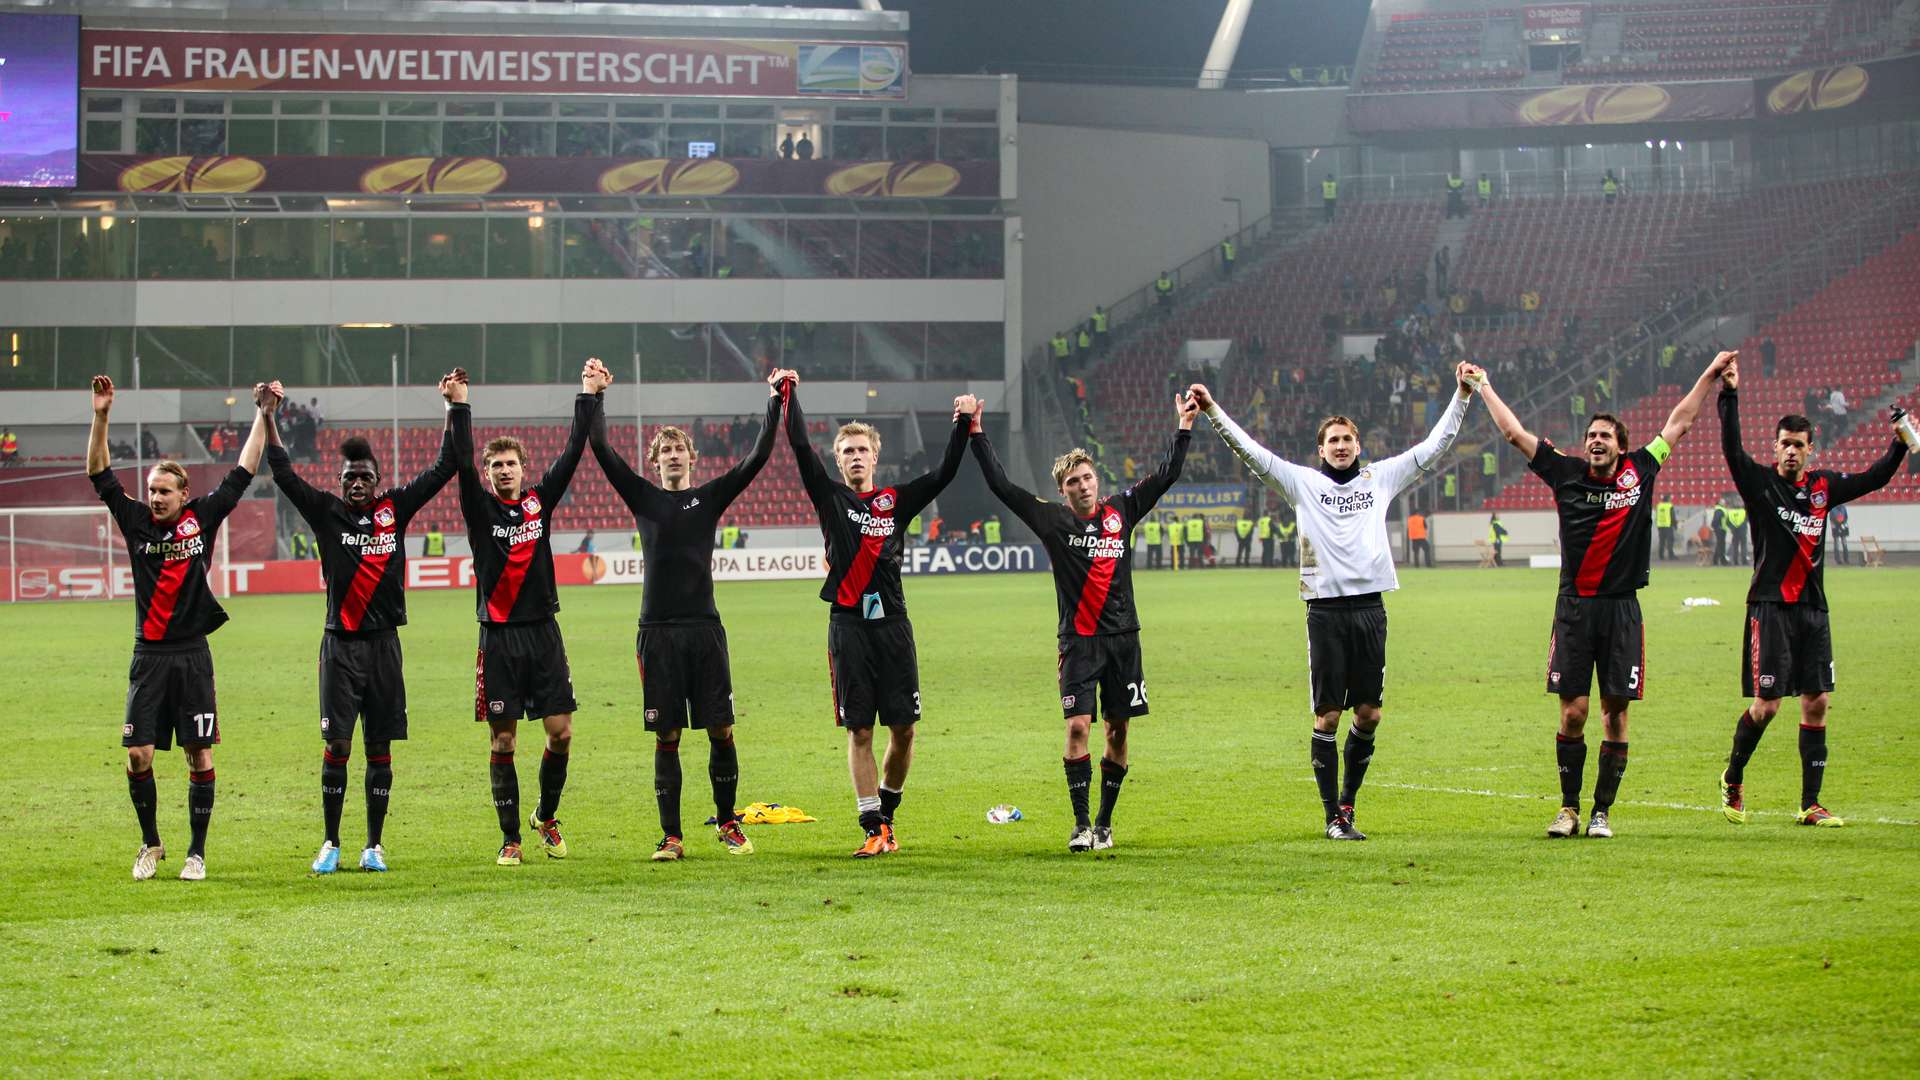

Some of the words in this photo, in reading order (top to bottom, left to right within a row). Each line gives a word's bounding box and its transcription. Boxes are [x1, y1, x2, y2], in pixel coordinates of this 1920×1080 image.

[92, 45, 172, 78] FIFA
[1161, 491, 1242, 504] METALIST
[1320, 491, 1374, 506] TelDaFax
[1586, 486, 1641, 503] TelDaFax
[1605, 494, 1641, 510] ENERGY
[1339, 500, 1374, 514] ENERGY
[847, 508, 895, 528] TelDaFax
[492, 518, 543, 538] TelDaFax
[860, 525, 895, 537] ENERGY
[341, 532, 396, 546] TelDaFax
[509, 528, 543, 546] ENERGY
[1068, 534, 1125, 549] TelDaFax
[164, 544, 205, 561] ENERGY
[361, 542, 397, 556] ENERGY
[1088, 548, 1125, 559] ENERGY
[746, 555, 817, 572] LEAGUE
[1628, 665, 1640, 690] 5
[193, 712, 215, 738] 17
